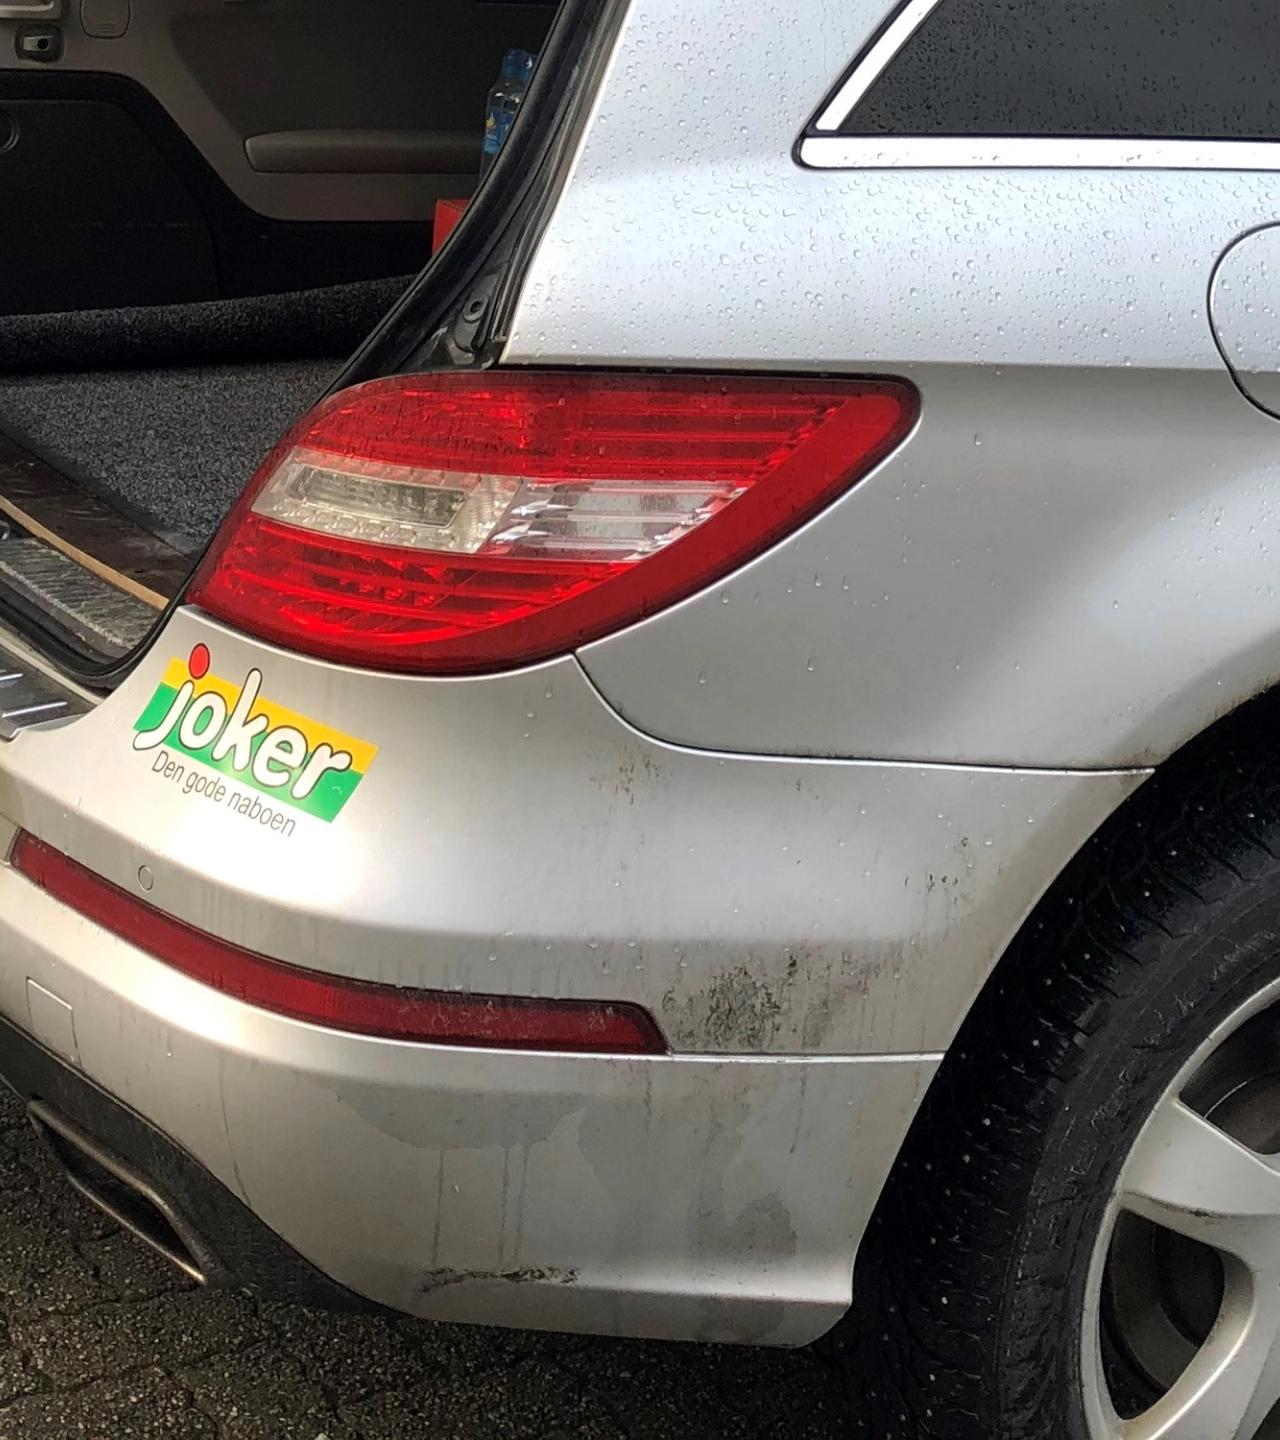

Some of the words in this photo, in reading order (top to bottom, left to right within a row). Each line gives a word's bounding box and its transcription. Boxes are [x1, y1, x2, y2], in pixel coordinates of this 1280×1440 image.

[132, 643, 353, 800] joker
[151, 750, 185, 782] Den
[182, 772, 226, 802] gode
[227, 790, 296, 837] naboen
